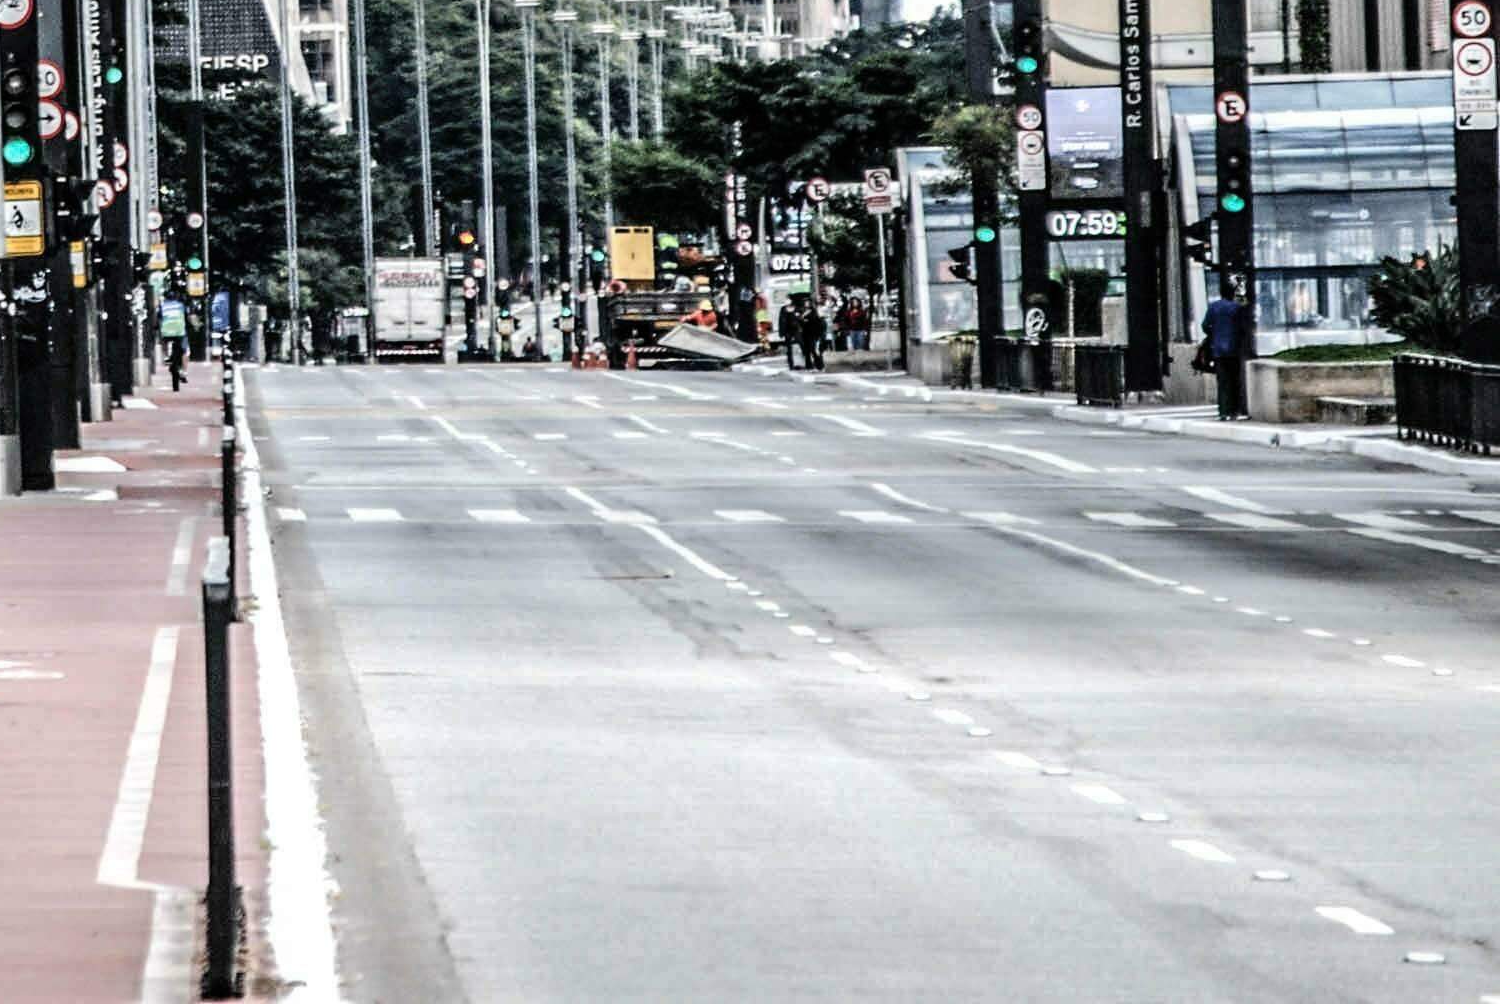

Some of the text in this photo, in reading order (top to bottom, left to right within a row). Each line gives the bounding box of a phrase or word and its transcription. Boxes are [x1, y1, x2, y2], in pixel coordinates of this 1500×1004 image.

[1461, 9, 1486, 27] 50
[198, 54, 269, 73] FIESP
[1125, 45, 1142, 105] Carlos
[1126, 110, 1142, 128] R.
[1053, 212, 1118, 236] 07:59
